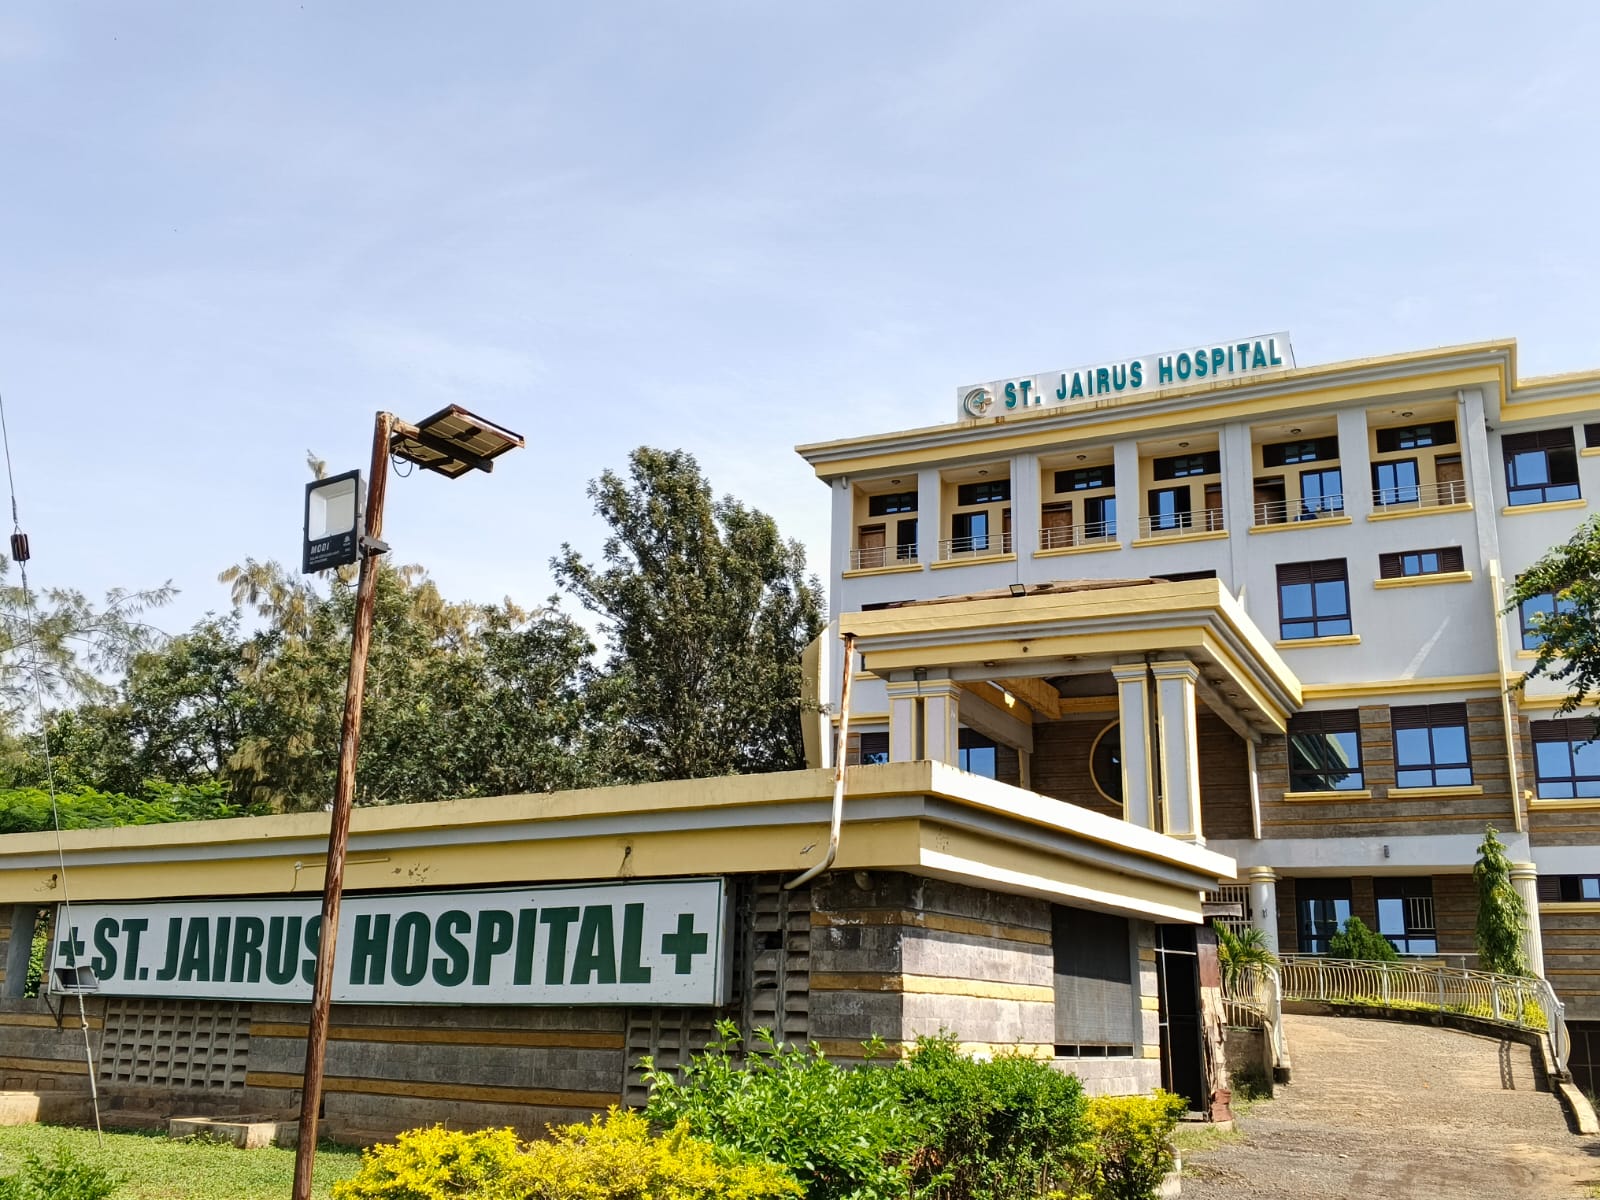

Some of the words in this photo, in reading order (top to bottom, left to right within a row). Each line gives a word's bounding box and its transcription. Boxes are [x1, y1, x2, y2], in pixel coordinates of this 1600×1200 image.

[1004, 379, 1042, 410] ST.
[1055, 360, 1143, 401] JAIRUS
[1157, 338, 1283, 385] HOSPITAL
[349, 902, 652, 988] HOSPITAL
